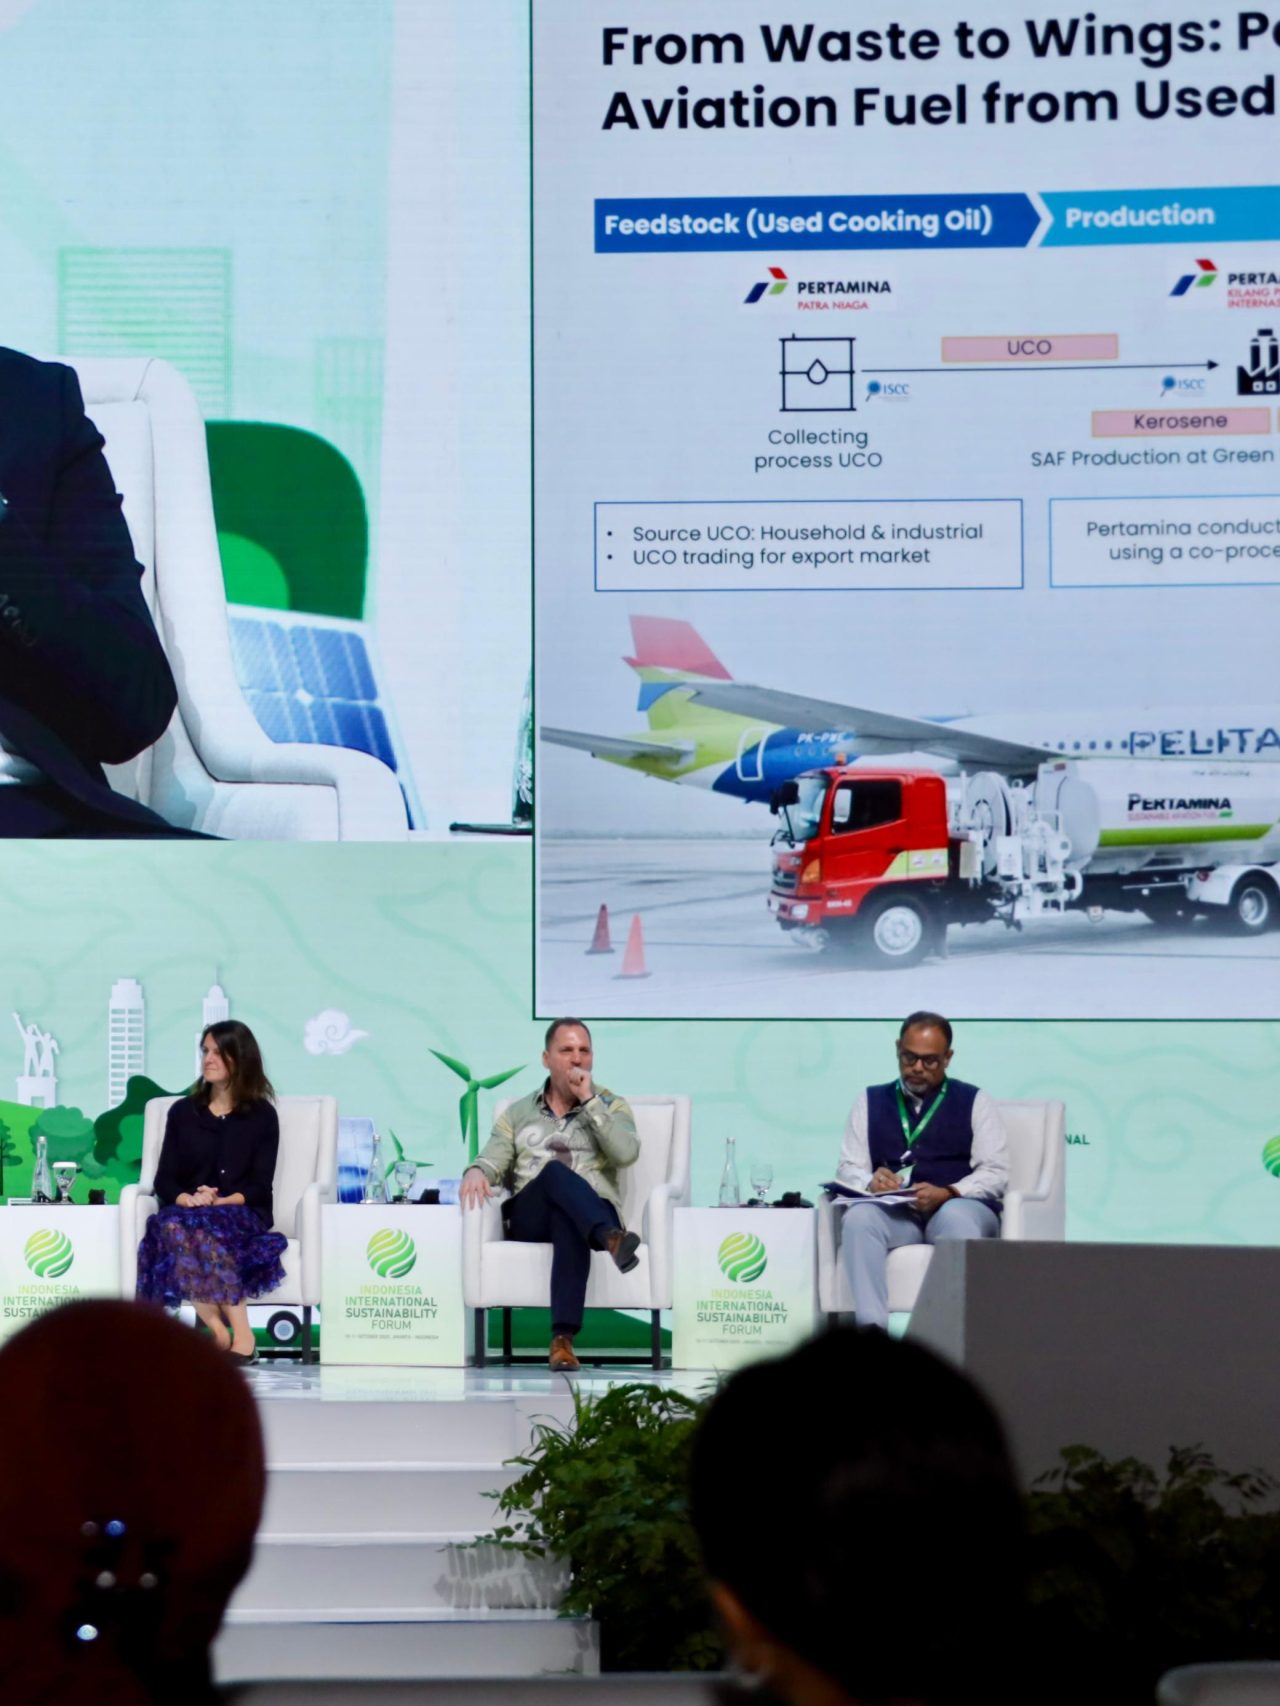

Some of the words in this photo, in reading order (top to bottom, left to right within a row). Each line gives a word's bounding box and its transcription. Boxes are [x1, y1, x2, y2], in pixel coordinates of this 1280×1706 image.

[602, 26, 744, 66] From
[760, 22, 940, 63] Waste
[955, 23, 1010, 60] to
[1026, 14, 1221, 68] Wings:
[1238, 12, 1280, 50] P
[601, 85, 837, 130] Aviation
[854, 83, 967, 127] Fuel
[982, 81, 1118, 124] from
[1136, 74, 1275, 120] Used
[604, 213, 740, 235] Feedstock
[746, 208, 823, 239] (Used
[828, 209, 939, 237] Cooking
[945, 205, 992, 236] Oil)
[1065, 203, 1215, 229] Production
[1228, 272, 1280, 285] PERTA
[797, 280, 891, 295] PERTAMINA
[1228, 288, 1270, 297] KILANG
[797, 301, 829, 310] PATRA
[832, 301, 869, 310] NIAGA
[1007, 340, 1052, 356] UCO
[883, 383, 910, 395] ISCC
[1178, 378, 1205, 390] ISCC
[1134, 413, 1228, 430] Kerosene
[768, 428, 868, 448] Collecting
[754, 453, 832, 473] process
[839, 453, 883, 468] UCO
[1031, 451, 1066, 467] SAF
[1072, 449, 1180, 466] Production
[1187, 449, 1207, 464] at
[1213, 448, 1274, 463] Green
[633, 525, 701, 542] Source
[707, 525, 756, 541] UCO:
[760, 523, 865, 541] Household
[871, 523, 886, 540] &
[891, 523, 983, 540] industrial
[1087, 520, 1191, 537] Pertamina
[633, 549, 677, 565] UCO
[683, 548, 754, 569] trading
[760, 547, 786, 564] for
[791, 547, 854, 568] export
[860, 547, 930, 564] market
[1109, 543, 1164, 564] using
[1169, 546, 1183, 559] a
[1128, 793, 1231, 811] PERTAMINA
[18, 1285, 80, 1295] INDONESIA
[360, 1285, 422, 1295] INDONESIA
[711, 1289, 773, 1299] INDONESIA
[345, 1296, 438, 1307] INTERNATIONAL
[696, 1301, 788, 1312] INTERNATIONAL
[345, 1308, 437, 1318] SUSTAINABILITY
[697, 1312, 788, 1323] SUSTAINABILITY
[371, 1320, 412, 1330] FORUM
[722, 1324, 762, 1335] FORUM
